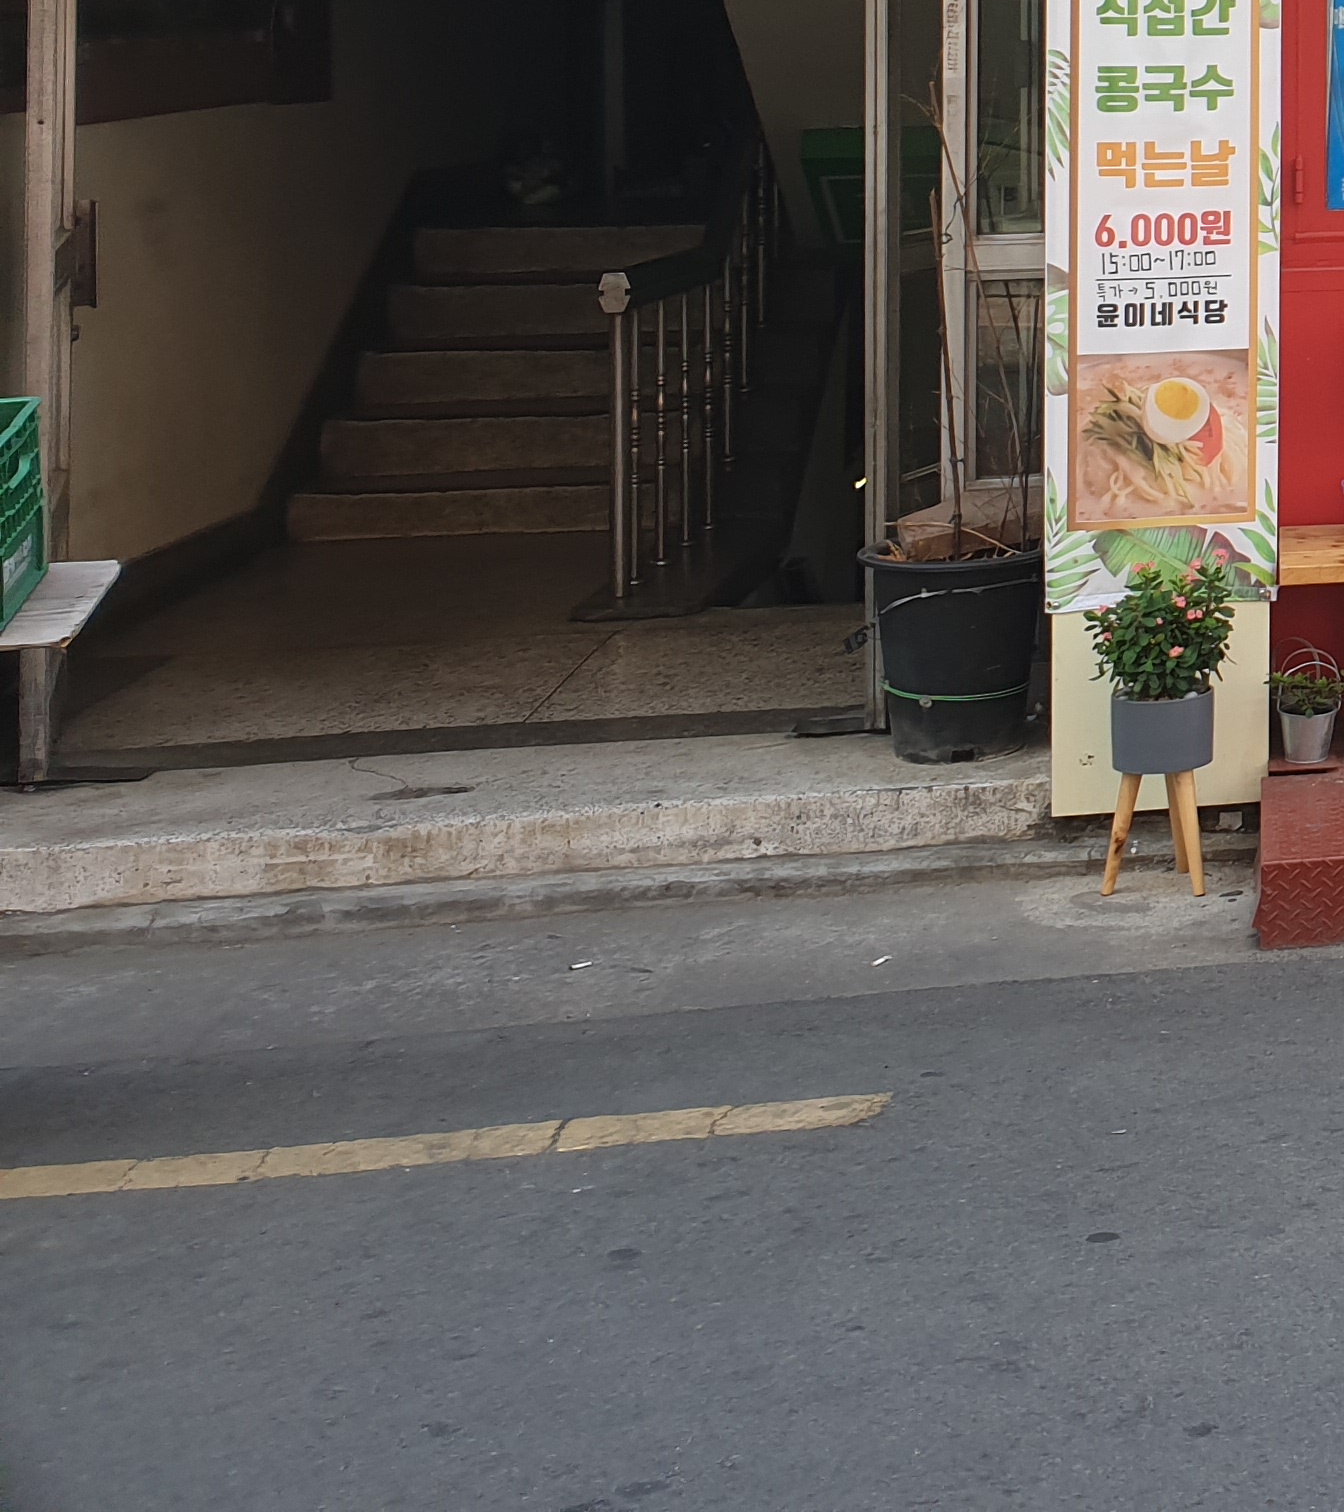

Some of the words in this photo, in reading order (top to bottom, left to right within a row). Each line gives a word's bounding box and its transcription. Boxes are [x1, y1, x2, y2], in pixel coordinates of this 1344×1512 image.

[1095, 64, 1235, 113] 콩국수
[1096, 140, 1237, 189] 먹는날
[1096, 299, 1229, 328] 윤이네식당
